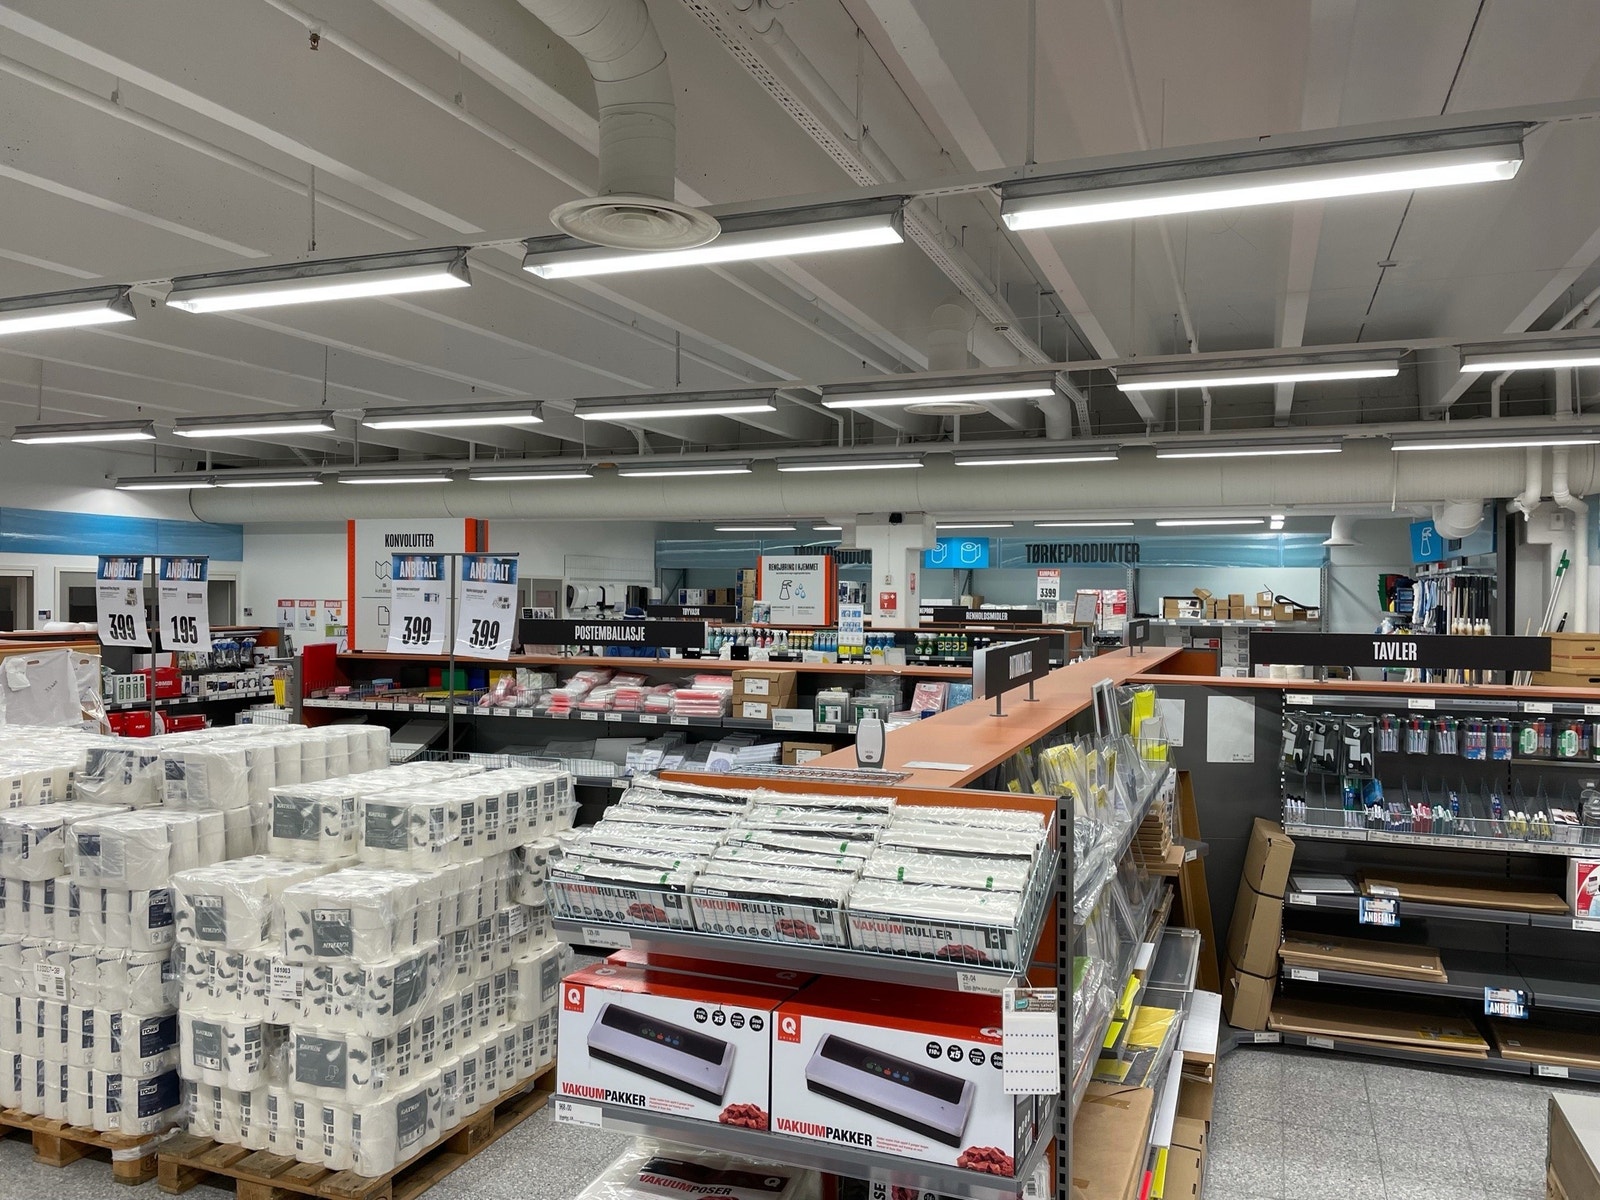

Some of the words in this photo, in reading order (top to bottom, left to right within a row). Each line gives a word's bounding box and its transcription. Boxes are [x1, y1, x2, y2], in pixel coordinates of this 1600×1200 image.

[384, 533, 434, 548] KONVOLUTTER
[1025, 543, 1140, 563] TØRKEPRODUKTER
[103, 562, 138, 579] ANBEFALT
[166, 562, 201, 579] ANBEFALT
[400, 561, 438, 578] ANBEFALT
[470, 562, 510, 582] ANBEFALT
[1040, 588, 1056, 598] 3399
[965, 611, 1008, 620] RENHOLDSMIDLER
[108, 614, 137, 640] 399
[170, 615, 198, 644] 195
[402, 616, 432, 645] 399
[469, 618, 500, 650] 399
[574, 625, 646, 642] POSTEMBALLASJE
[1372, 641, 1418, 661] TAVLER
[695, 899, 785, 916] VAKUUMRULLER
[1364, 911, 1396, 925] ANBEFALT
[853, 920, 953, 940] VAKUUMRULLER
[568, 988, 580, 1005] Q
[1489, 1001, 1524, 1017] ANBEFALT
[782, 1017, 796, 1035] Q
[562, 1082, 646, 1107] VAKUUMPAKKER
[777, 1118, 872, 1147] VAKUUMPAKKER
[639, 1174, 733, 1196] VAKUUMPOSER
